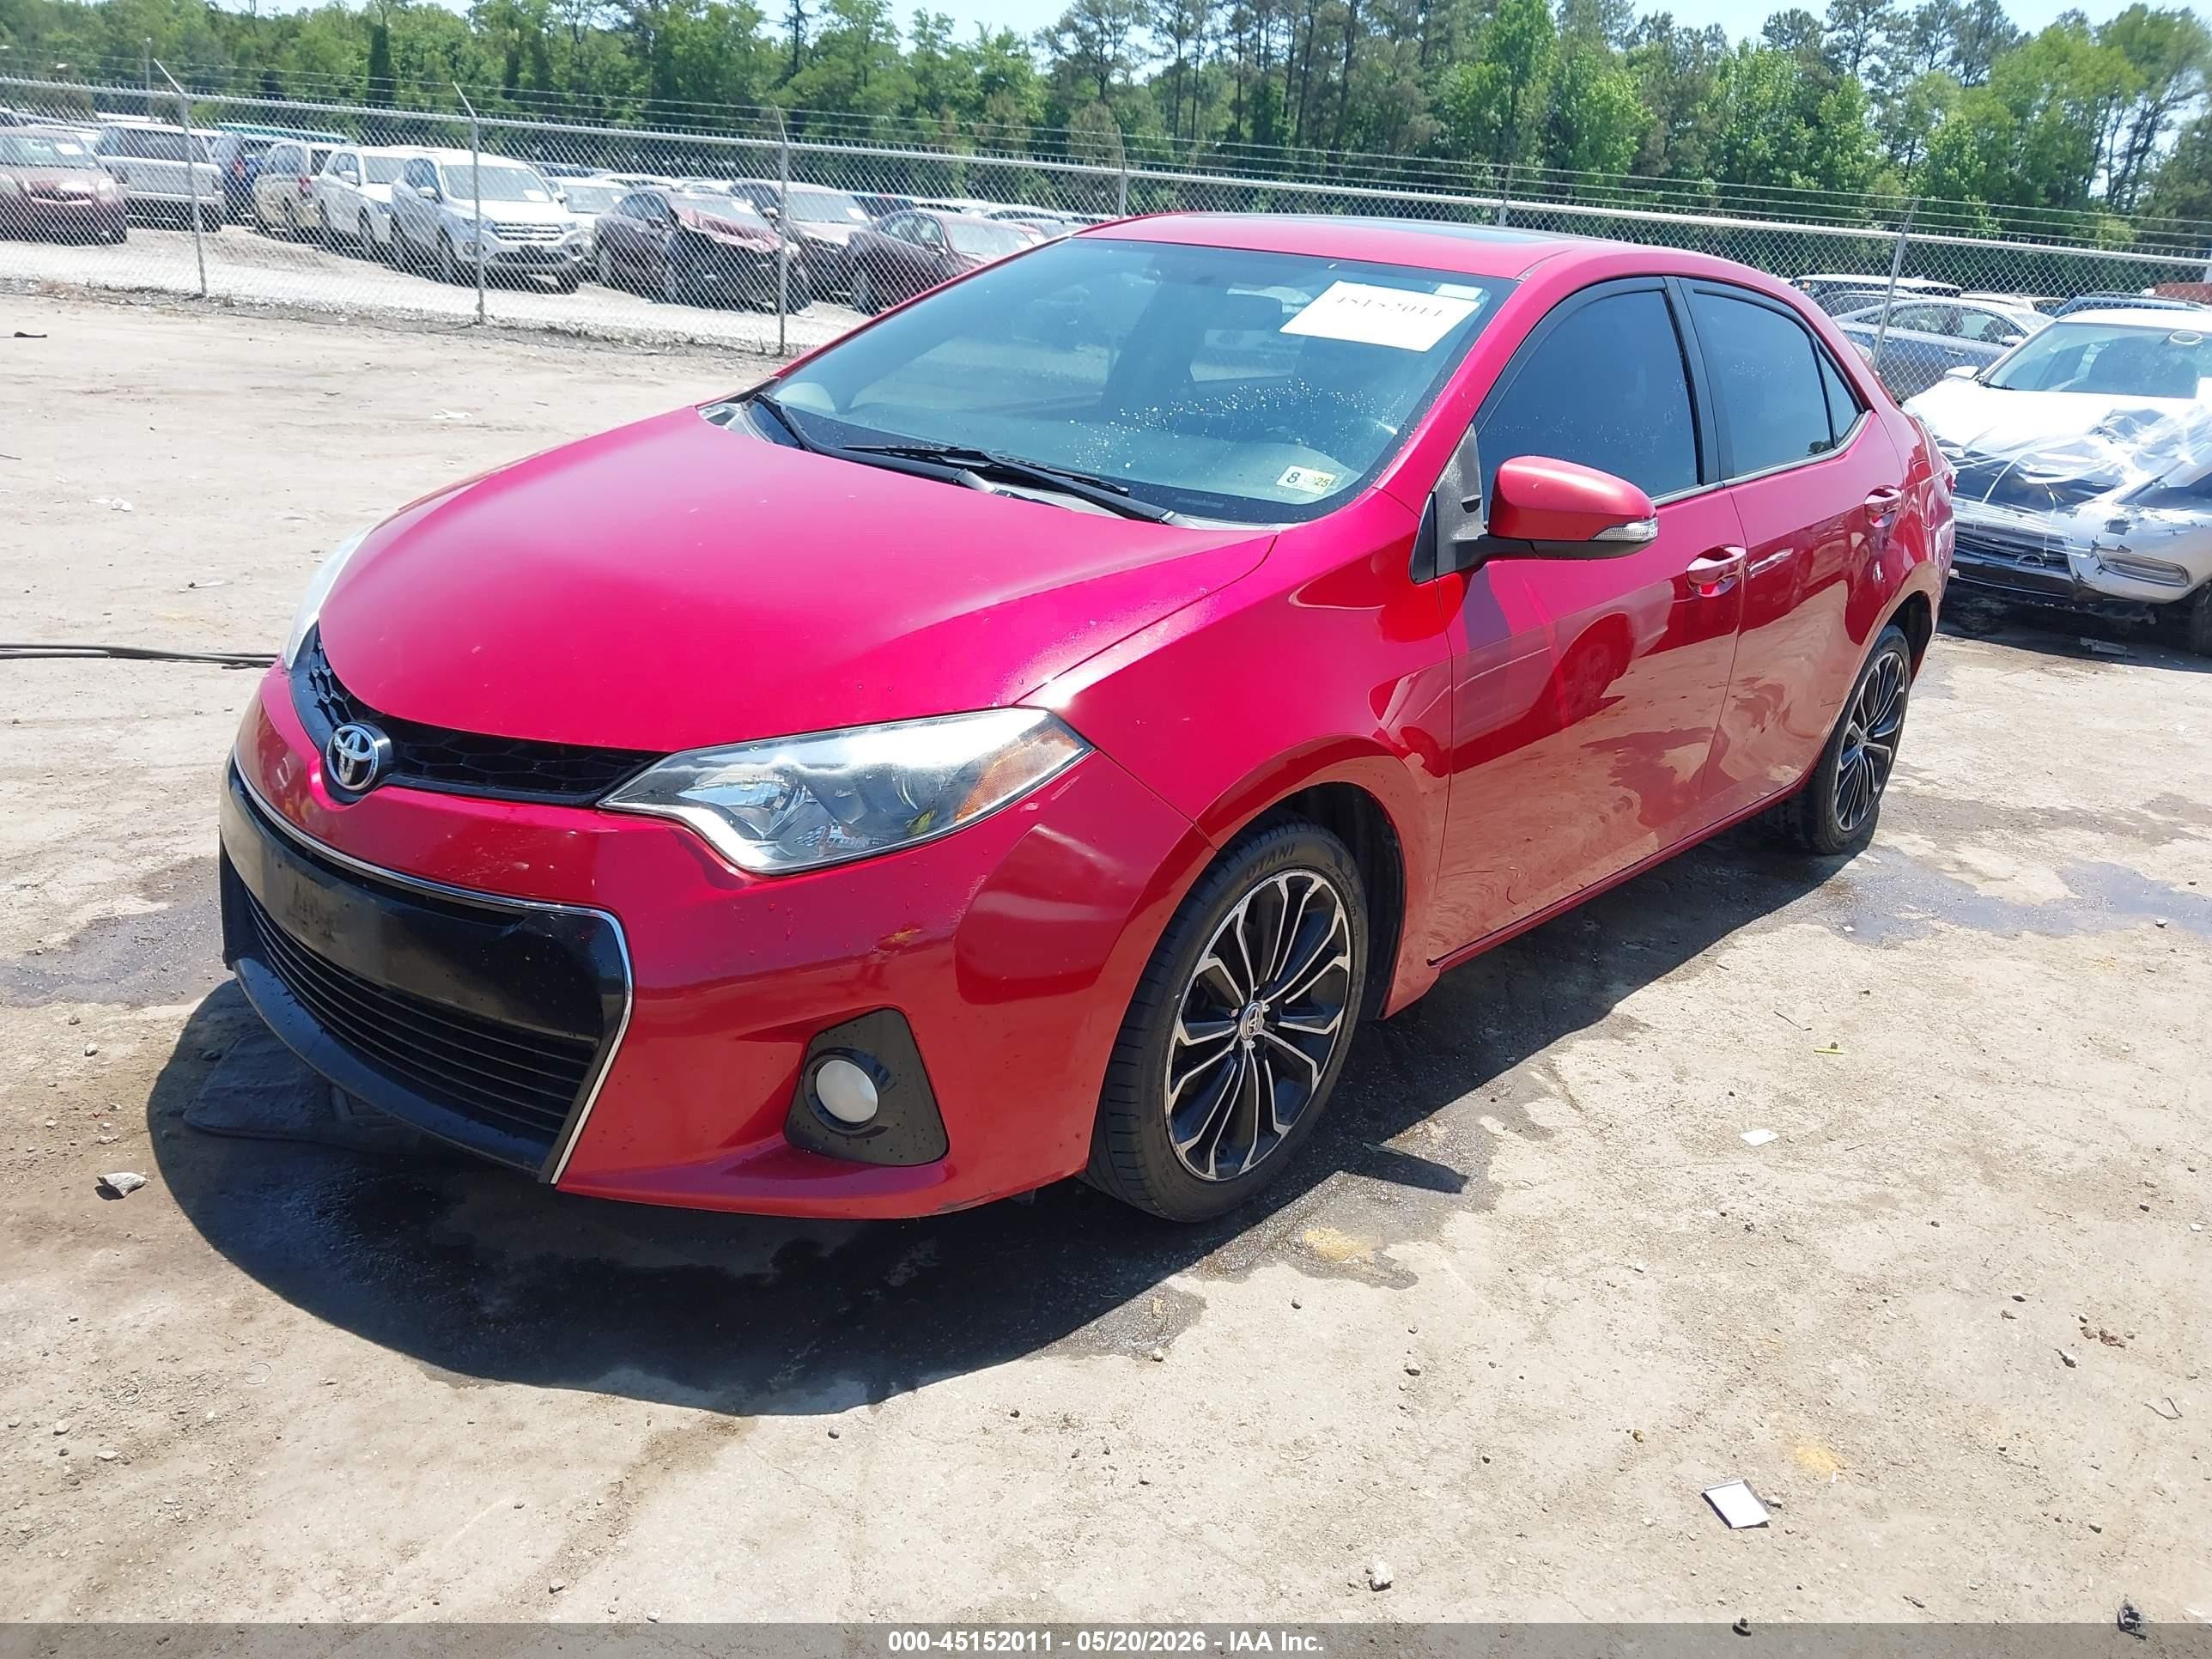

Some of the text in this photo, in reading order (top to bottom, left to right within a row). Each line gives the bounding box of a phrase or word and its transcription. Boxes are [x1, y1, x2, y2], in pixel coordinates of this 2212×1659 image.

[1286, 471, 1300, 483] 8
[1314, 477, 1330, 487] 25
[1247, 842, 1295, 878] OTANI
